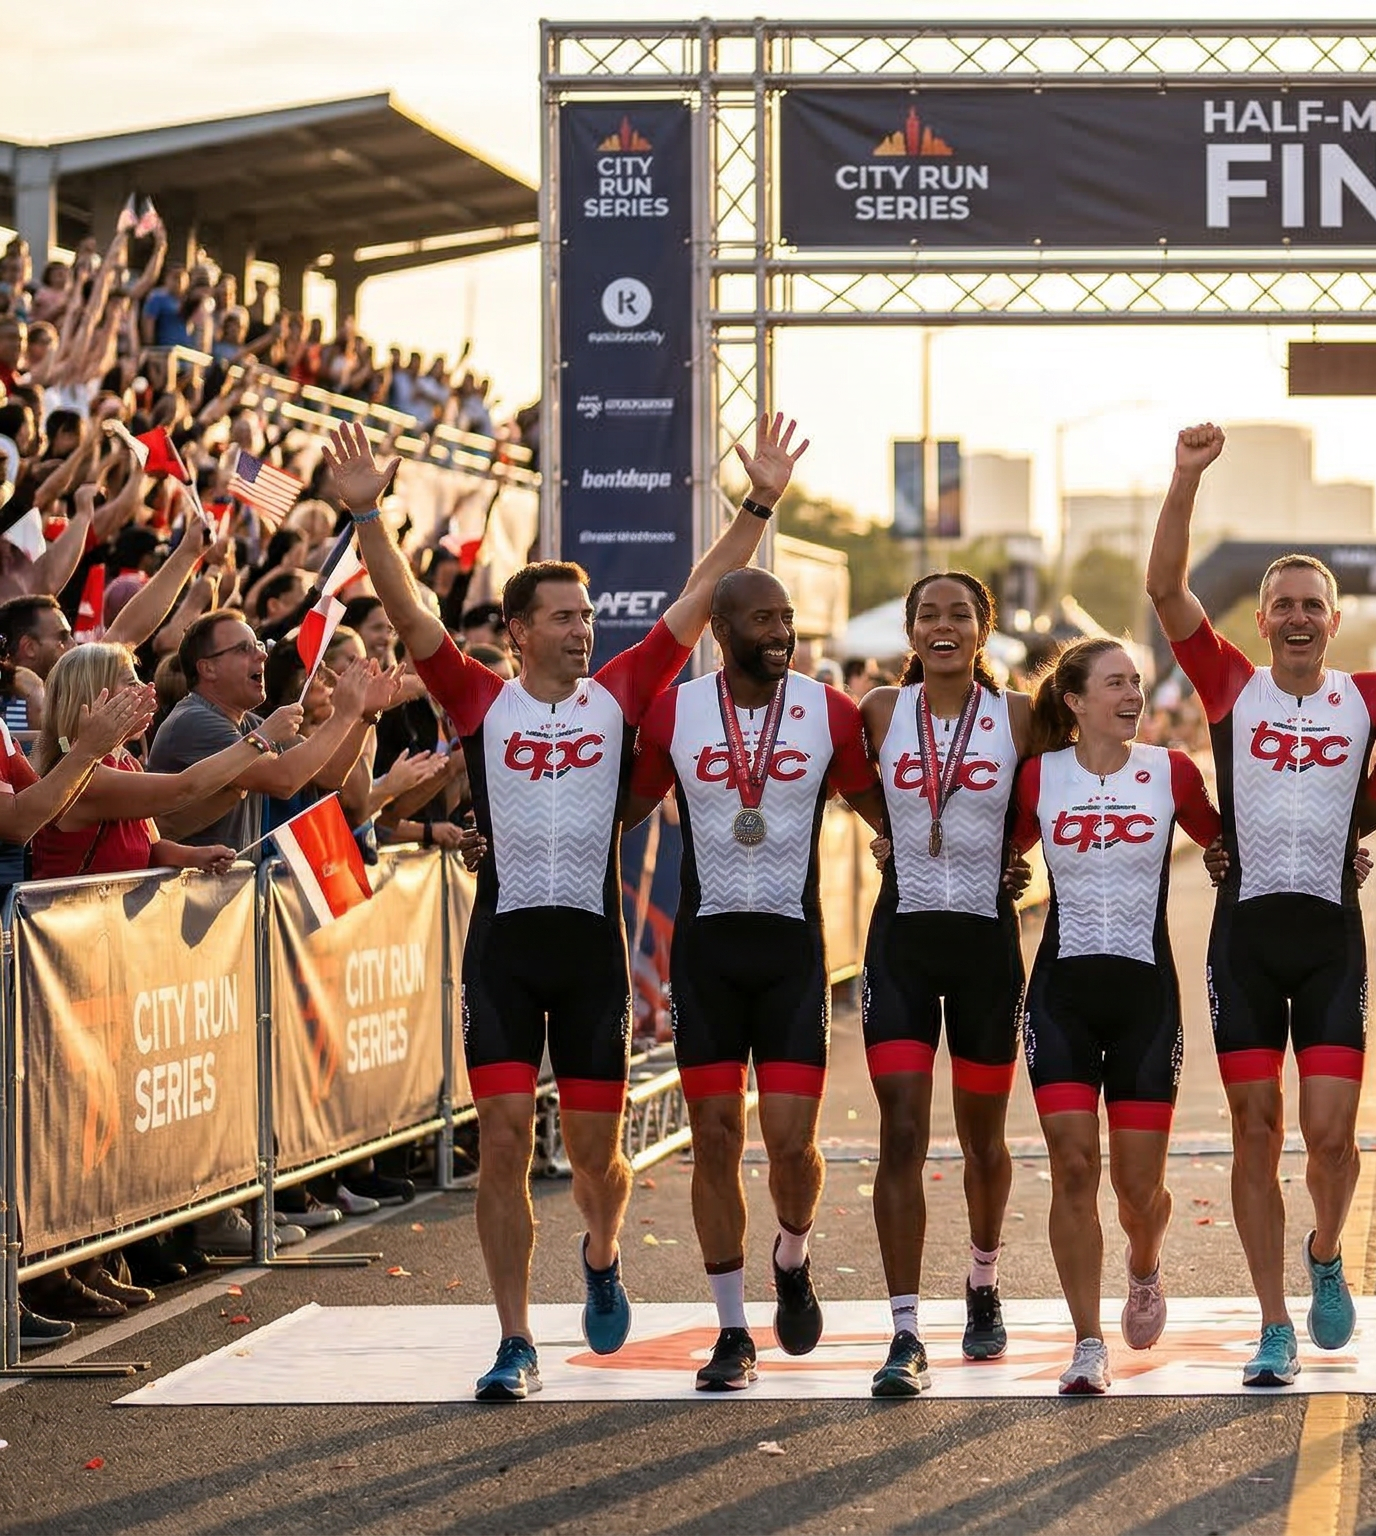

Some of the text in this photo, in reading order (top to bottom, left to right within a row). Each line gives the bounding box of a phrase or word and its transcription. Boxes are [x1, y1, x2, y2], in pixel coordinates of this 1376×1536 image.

[597, 156, 653, 176] CITY
[835, 165, 989, 190] CITY RUN
[600, 177, 652, 196] RUN
[583, 198, 670, 218] SERIES
[855, 195, 970, 221] SERIES
[345, 942, 426, 1010] CITY RUN
[133, 973, 240, 1056] CITY RUN
[346, 1007, 408, 1074] SERIES
[134, 1051, 217, 1134] SERIES
